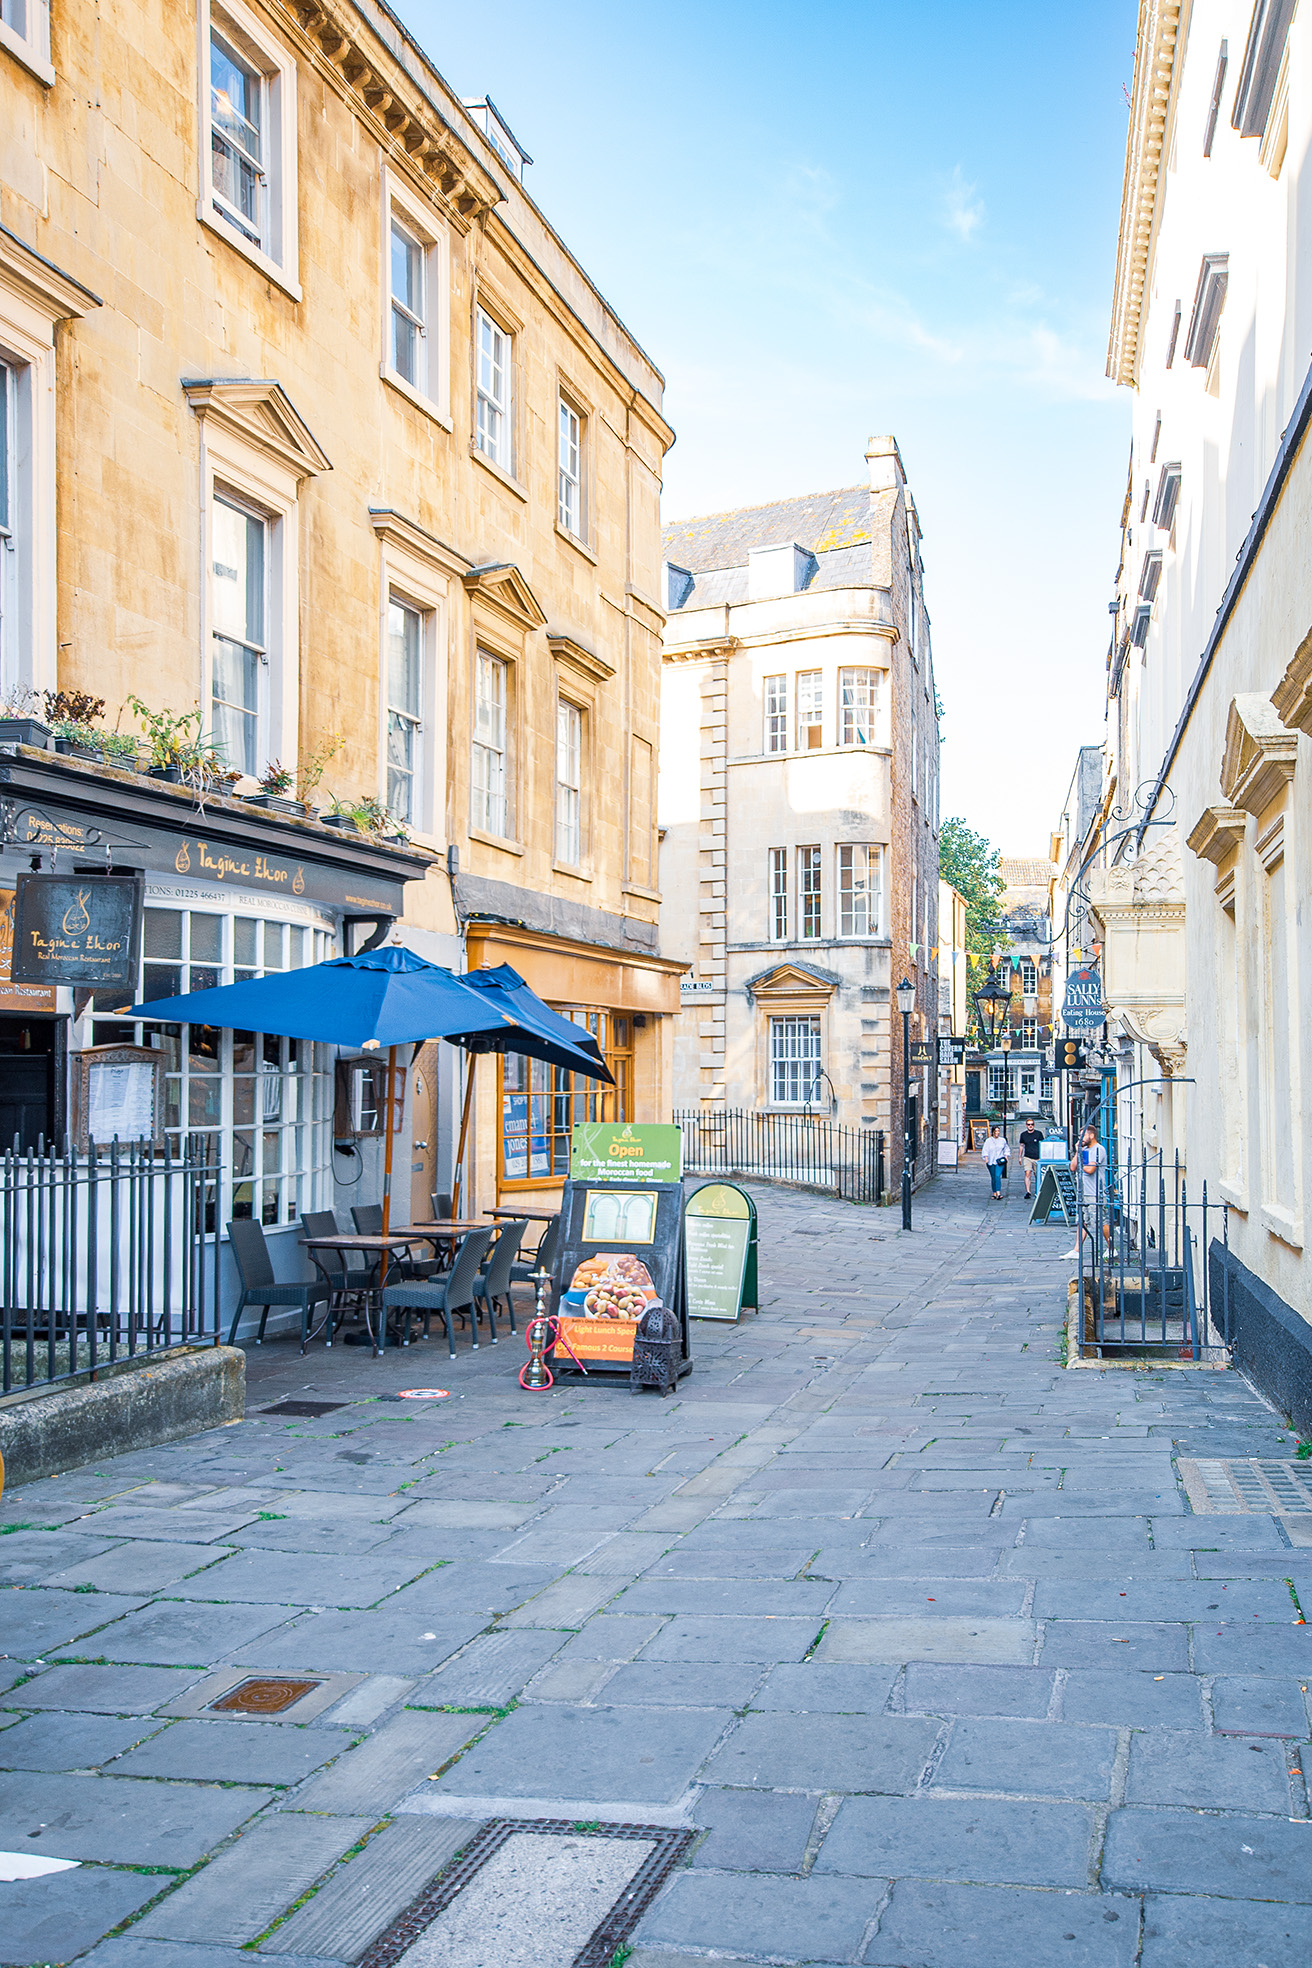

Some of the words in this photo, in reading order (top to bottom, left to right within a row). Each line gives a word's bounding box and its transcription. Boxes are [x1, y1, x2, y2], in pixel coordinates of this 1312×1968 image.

[28, 815, 84, 837] Reservations:
[197, 842, 250, 879] Tagine
[175, 888, 199, 899] 01225
[200, 891, 225, 902] 466437
[239, 895, 255, 906] REAL
[30, 930, 80, 953] Tagine
[38, 951, 50, 960] Real
[51, 952, 78, 961] Moroccan
[80, 954, 111, 963] Restaurant
[15, 984, 51, 998] Restaurant
[1068, 983, 1100, 995] SALLY
[1062, 1009, 1083, 1017] Eating
[1075, 1017, 1094, 1026] 1680
[608, 1143, 644, 1158] Open
[580, 1159, 592, 1167] for
[593, 1159, 606, 1167] the
[607, 1160, 628, 1168] finest
[629, 1160, 672, 1169] homemade
[597, 1168, 635, 1176] Moroccan
[636, 1169, 654, 1177] food
[574, 1326, 592, 1334] Light
[594, 1326, 616, 1334] Lunch
[573, 1343, 600, 1351] Famous
